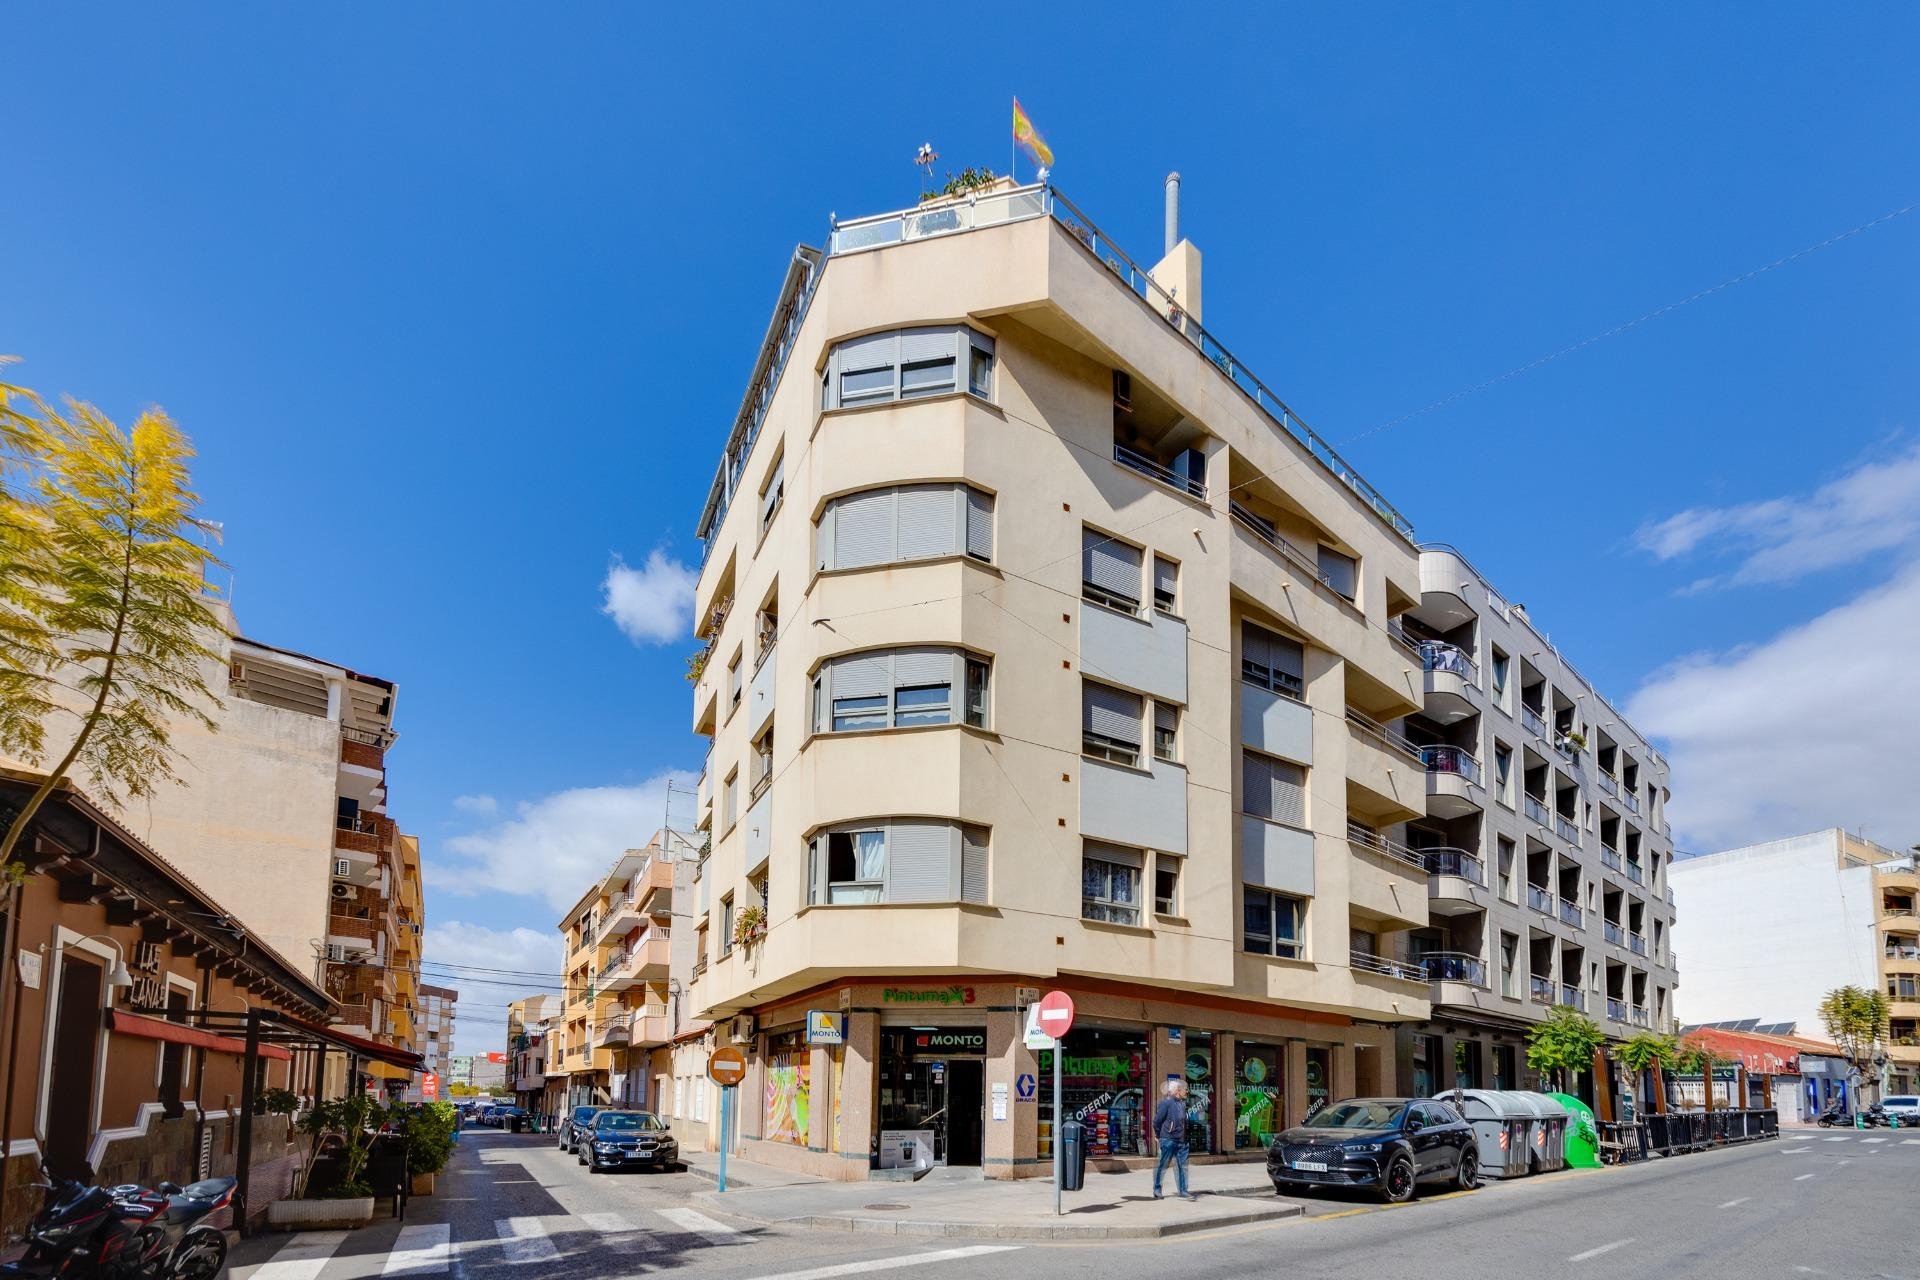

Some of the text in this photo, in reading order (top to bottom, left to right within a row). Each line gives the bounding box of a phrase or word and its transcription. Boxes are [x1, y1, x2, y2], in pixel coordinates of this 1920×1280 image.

[930, 1035, 984, 1045] MONTO
[1030, 1028, 1044, 1036] MON
[1076, 1092, 1112, 1121] OFERTA
[1244, 1097, 1270, 1119] OFERTA
